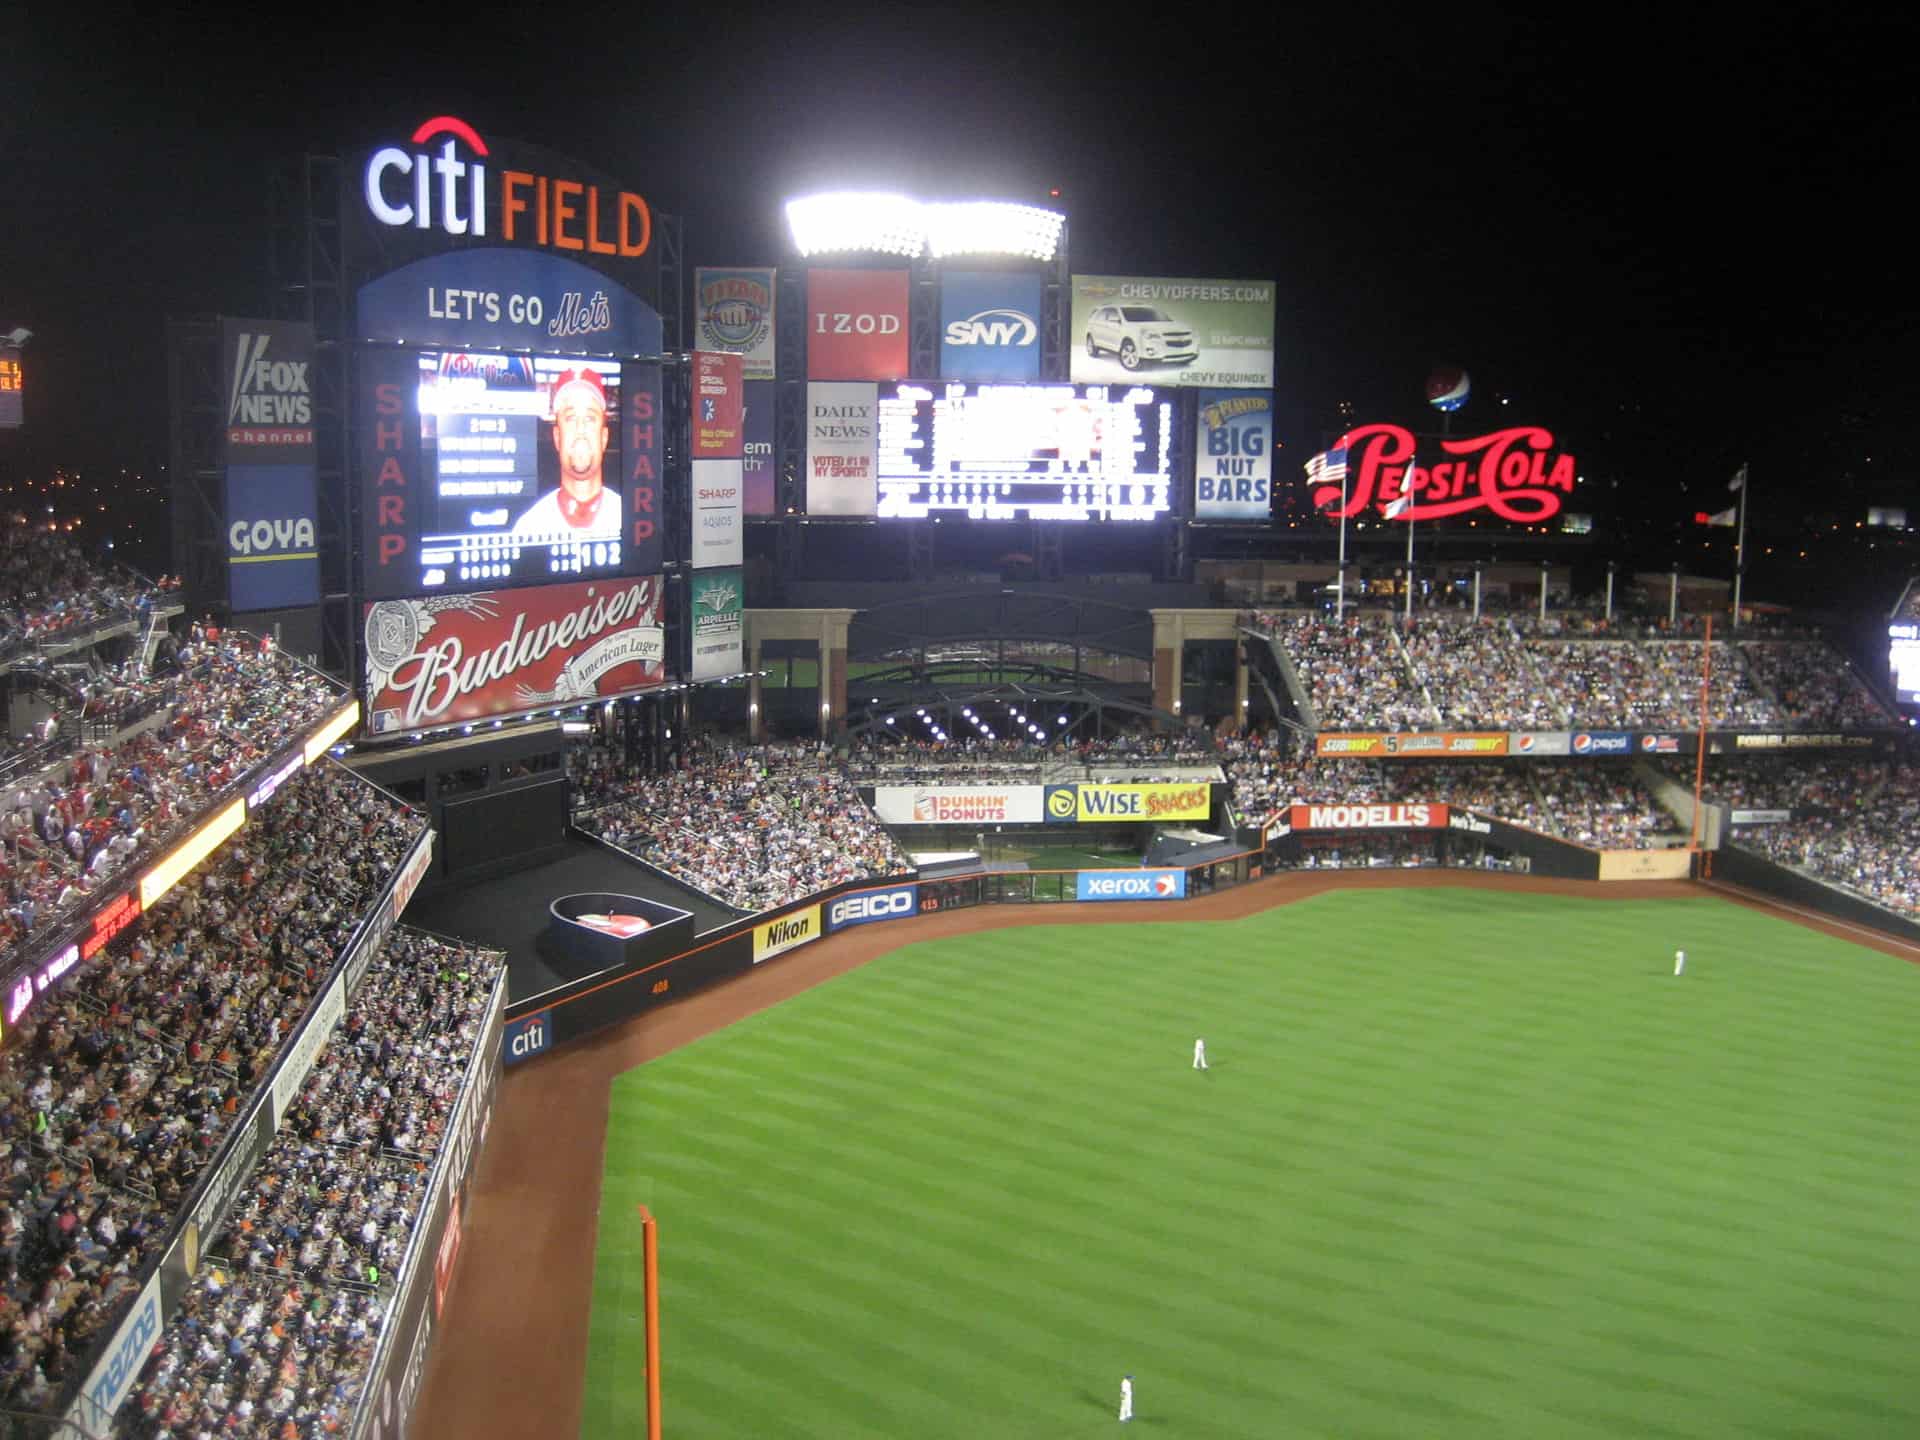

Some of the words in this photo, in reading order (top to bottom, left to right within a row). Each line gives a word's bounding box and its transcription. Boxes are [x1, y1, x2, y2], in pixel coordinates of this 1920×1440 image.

[364, 139, 487, 236] citi
[503, 170, 652, 257] FIELD
[1120, 284, 1269, 301] CHEVYOFFERS.COM
[428, 287, 500, 325] LET'S
[508, 294, 544, 325] GO
[548, 290, 611, 337] Mets
[815, 312, 900, 335] IZOD
[944, 315, 1030, 346] SNY
[255, 360, 310, 393] FOX
[1179, 371, 1215, 384] CHEVY
[1217, 372, 1266, 385] EQUINOX
[240, 395, 312, 425] NEWS
[814, 405, 871, 418] DAILY
[231, 430, 313, 444] channel
[813, 425, 871, 438] NEWS
[1207, 427, 1264, 456] BIG
[376, 383, 407, 566] SHARP
[633, 392, 655, 546] SHARP
[1216, 459, 1256, 476] NUT
[698, 488, 737, 499] SHARP
[1198, 478, 1268, 502] BARS
[229, 518, 315, 555] GOYA
[581, 542, 621, 567] 102
[389, 580, 649, 728] Budweiser
[577, 643, 628, 683] American
[630, 638, 660, 655] Lager
[1592, 736, 1627, 751] pepsi
[939, 796, 1009, 808] DUNKIN'
[939, 809, 1006, 820] DONUTS
[1144, 786, 1207, 817] SNACKS
[1308, 804, 1431, 828] MODELL'S
[1087, 877, 1152, 897] xerox
[831, 891, 913, 925] GEICO
[766, 917, 809, 948] Nikon
[512, 1025, 543, 1056] citi
